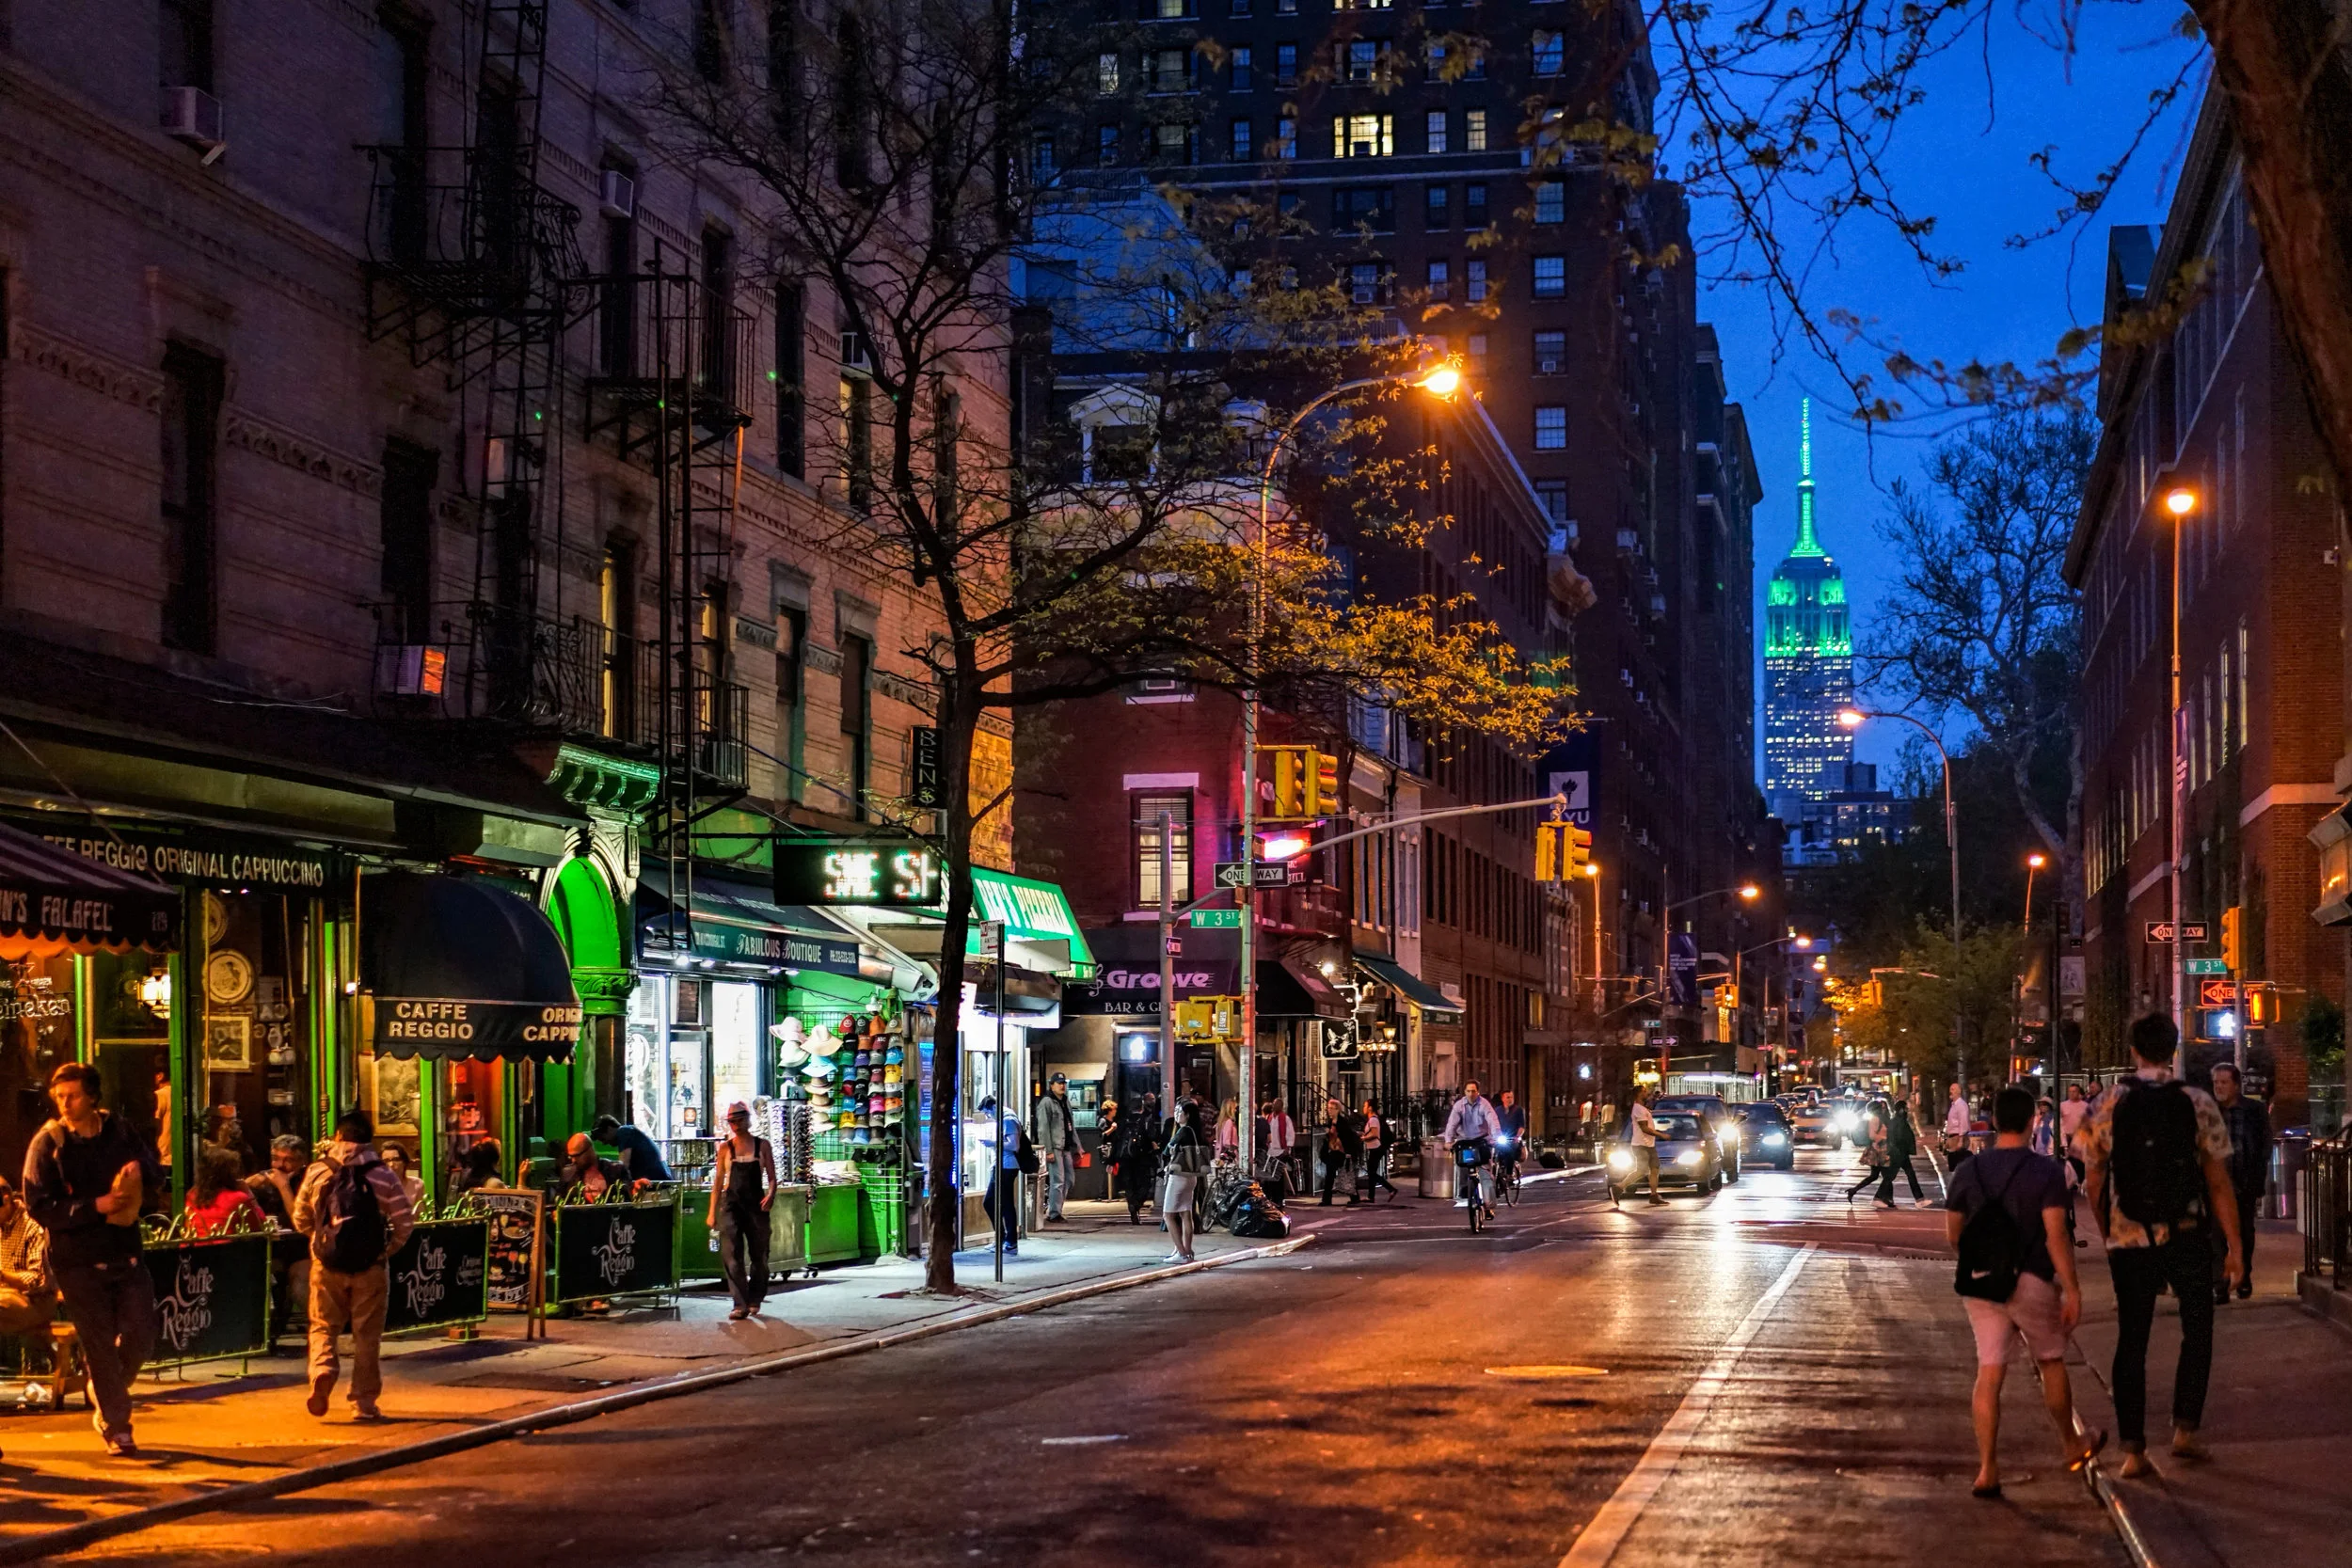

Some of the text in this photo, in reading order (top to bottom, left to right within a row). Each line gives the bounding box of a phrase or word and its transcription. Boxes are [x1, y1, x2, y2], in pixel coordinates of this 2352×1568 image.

[1550, 811, 1590, 824] YU
[154, 847, 229, 879] ORIGINAL
[232, 855, 324, 887] CAPPUCCINO
[1256, 867, 1279, 881] WAY
[41, 895, 113, 932] FALAFEL
[1011, 885, 1074, 936] PIZZERIA
[1196, 912, 1205, 926] W
[1215, 912, 1222, 926] 3
[737, 933, 780, 958] FABULOUS
[782, 939, 821, 963] BOUTIQUE
[2188, 961, 2197, 972] W
[2204, 961, 2211, 972] 3
[1104, 1002, 1131, 1013] BAR
[1136, 1002, 1145, 1012] &
[2211, 989, 2233, 997] ONE
[396, 1003, 468, 1021] CAFFE
[389, 1022, 473, 1039] REGGIO
[1070, 1091, 1078, 1101] A
[609, 1215, 636, 1254] Caffe
[418, 1235, 447, 1280] Caffe
[592, 1244, 635, 1286] Reggio
[175, 1255, 214, 1307] Caffe
[398, 1270, 445, 1318] Reggio
[153, 1295, 212, 1351] Reggio
